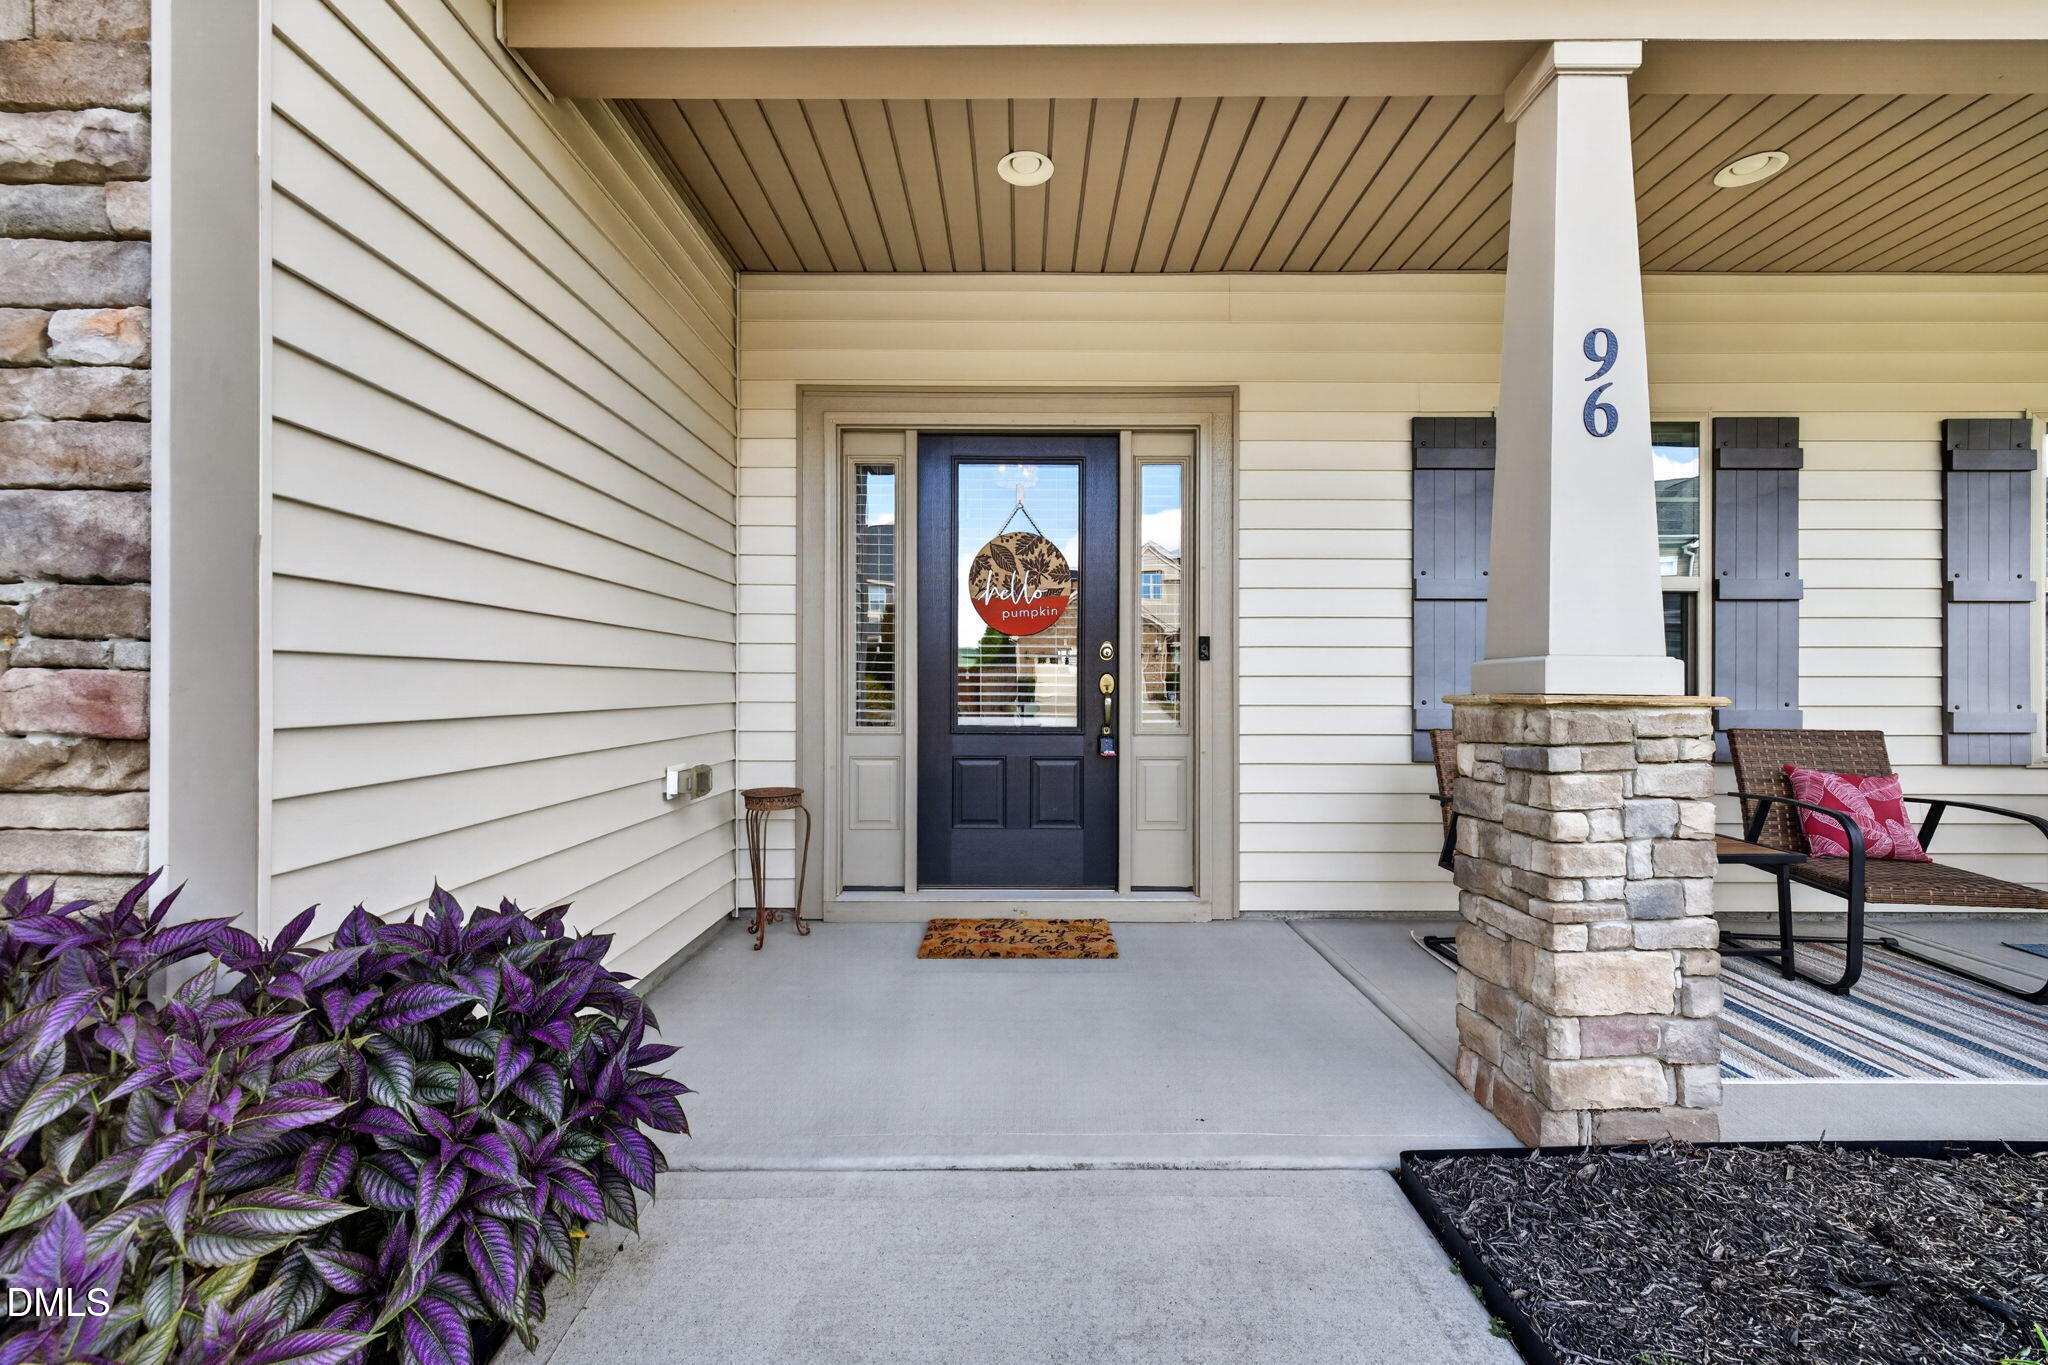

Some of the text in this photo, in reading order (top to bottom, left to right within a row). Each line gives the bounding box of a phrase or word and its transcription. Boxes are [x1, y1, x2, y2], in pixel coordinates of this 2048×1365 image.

[1583, 328, 1618, 437] 96
[978, 570, 1048, 605] hello
[1002, 606, 1058, 620] pumpkin
